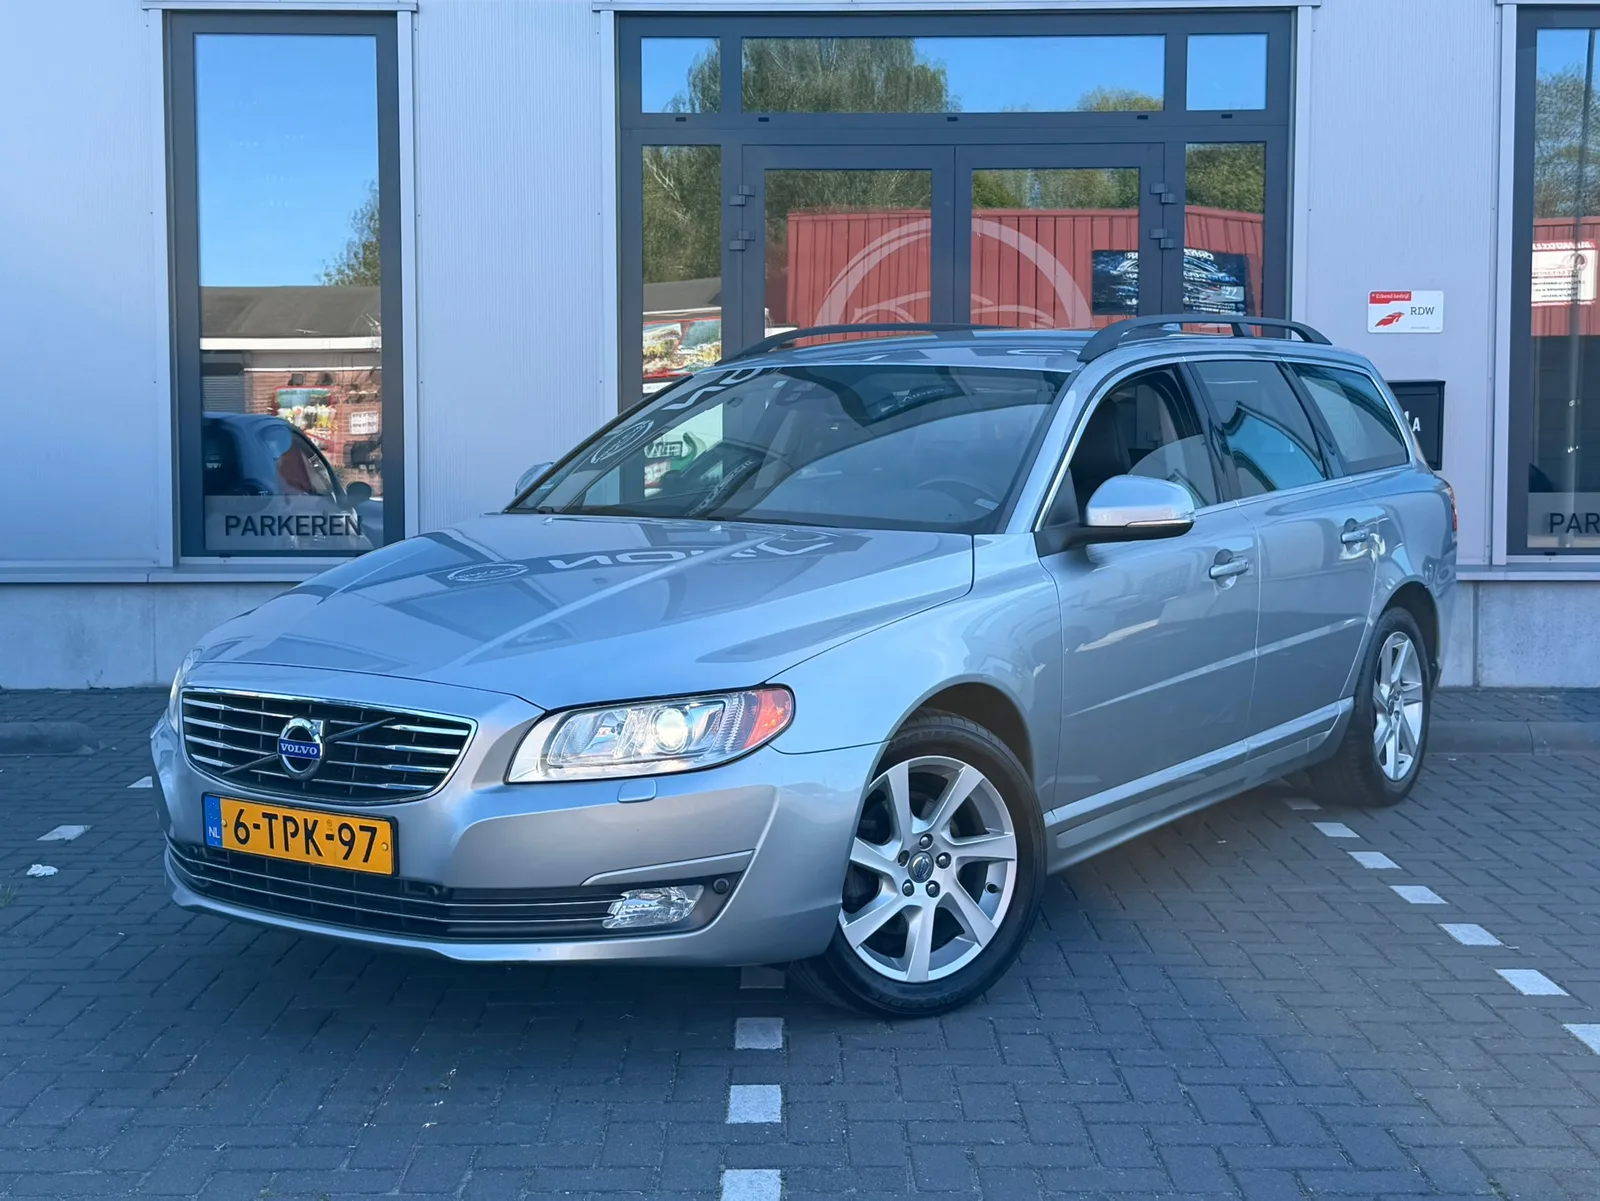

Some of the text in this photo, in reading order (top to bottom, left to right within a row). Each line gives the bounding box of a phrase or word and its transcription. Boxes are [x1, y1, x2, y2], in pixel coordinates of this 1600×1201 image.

[1410, 307, 1435, 315] RDW
[225, 515, 362, 537] PARKEREN
[1550, 512, 1600, 534] PAR
[280, 743, 318, 756] VOLVO
[208, 825, 221, 839] NL
[234, 809, 377, 863] 6-TPK-97
